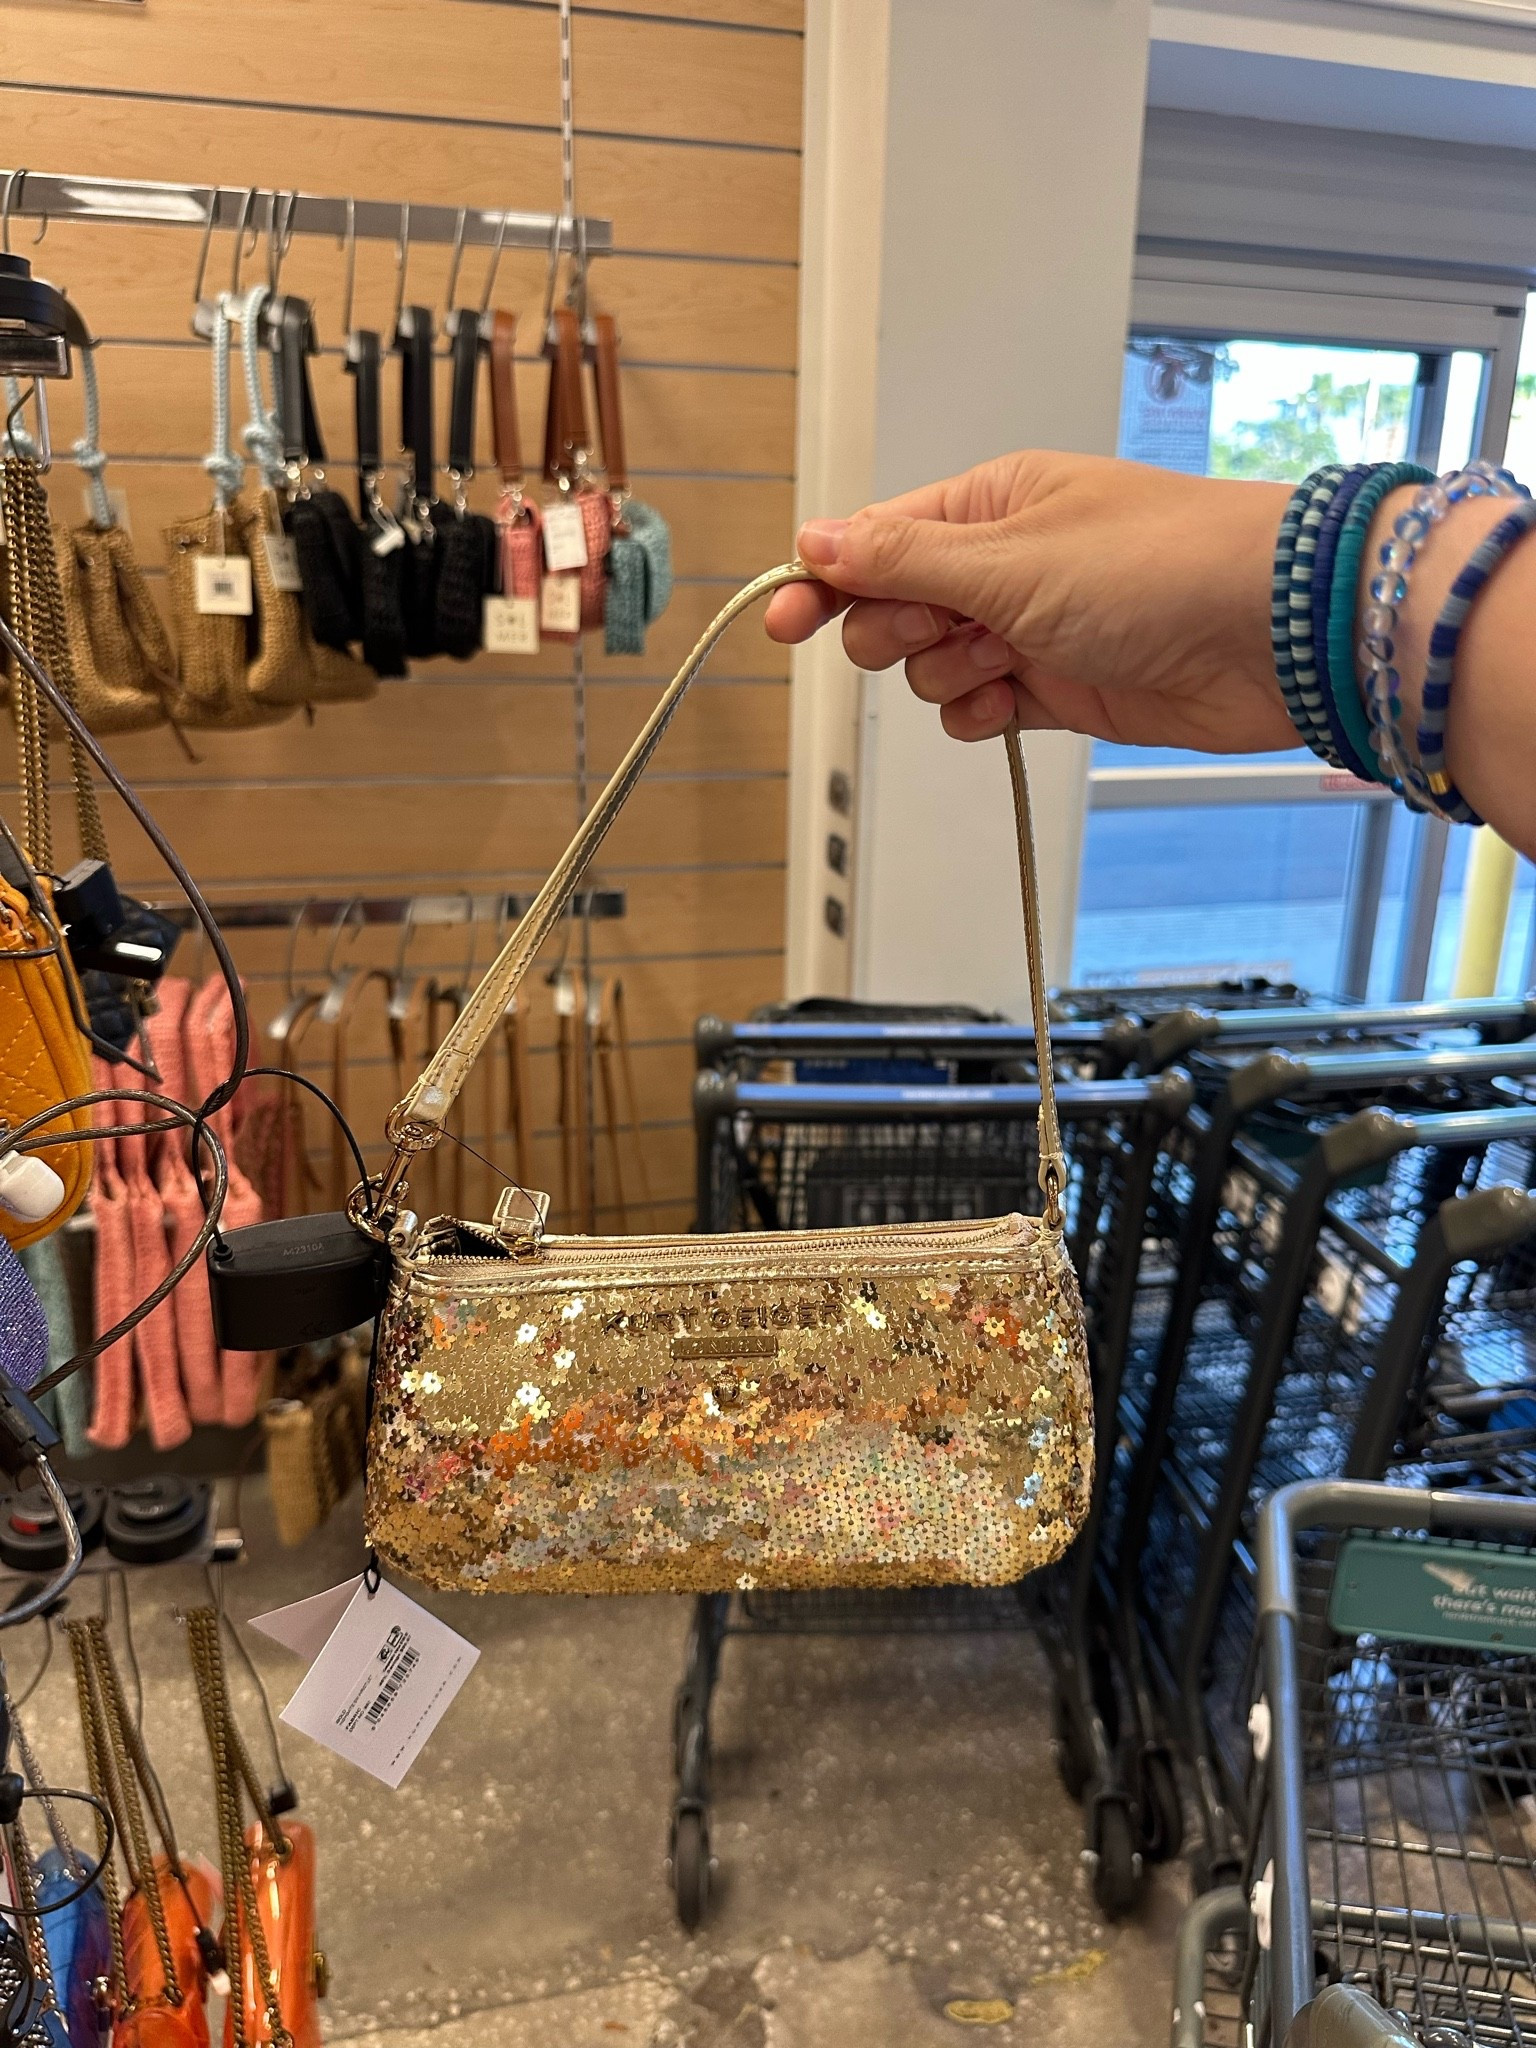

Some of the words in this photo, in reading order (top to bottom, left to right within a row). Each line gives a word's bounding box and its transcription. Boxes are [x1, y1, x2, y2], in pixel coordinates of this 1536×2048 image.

[600, 1307, 698, 1335] KURT
[709, 1299, 842, 1330] GEIGER
[680, 1338, 769, 1354] LONDON
